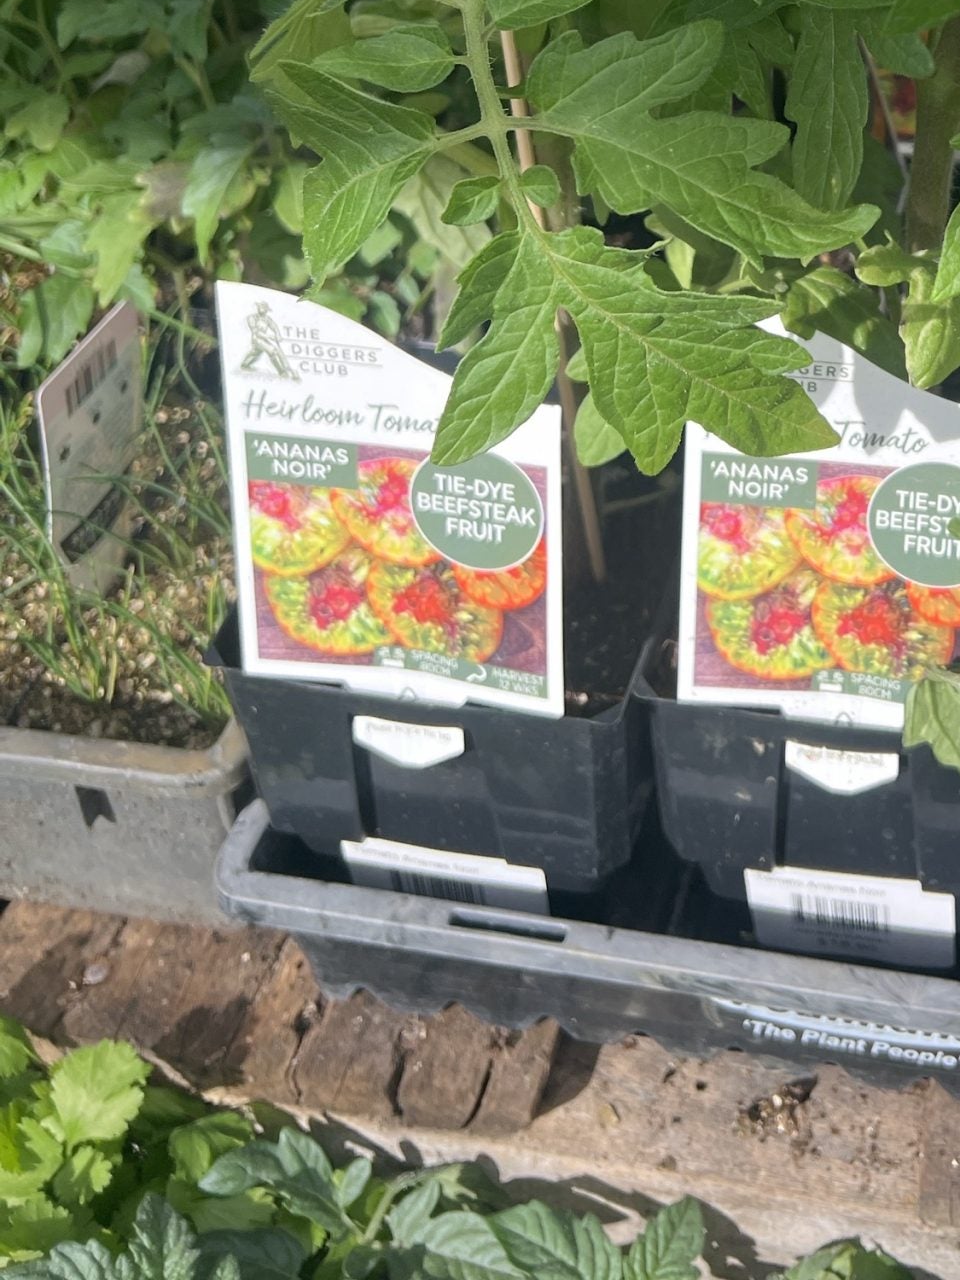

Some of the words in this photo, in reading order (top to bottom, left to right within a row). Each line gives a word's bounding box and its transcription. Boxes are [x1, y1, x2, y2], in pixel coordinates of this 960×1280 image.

[283, 324, 321, 341] THE
[291, 343, 378, 363] DIGGERS
[300, 362, 349, 376] CLUB
[242, 389, 364, 425] Heirloom
[369, 404, 440, 435] Toma
[834, 420, 929, 454] Tomato
[254, 439, 349, 465] 'ANANAS
[273, 459, 333, 480] NOIR'
[710, 462, 809, 483] 'ANANAS
[433, 472, 515, 502] TIE-DYE
[727, 479, 789, 500] NOIR'
[416, 490, 536, 528] BEEFSTEAK
[445, 519, 507, 543] FRUIT
[411, 649, 459, 669] SPACING
[491, 668, 544, 686] HARVEST
[850, 672, 901, 690] SPACING
[743, 1019, 797, 1042] 'The
[801, 1030, 866, 1054] Plant
